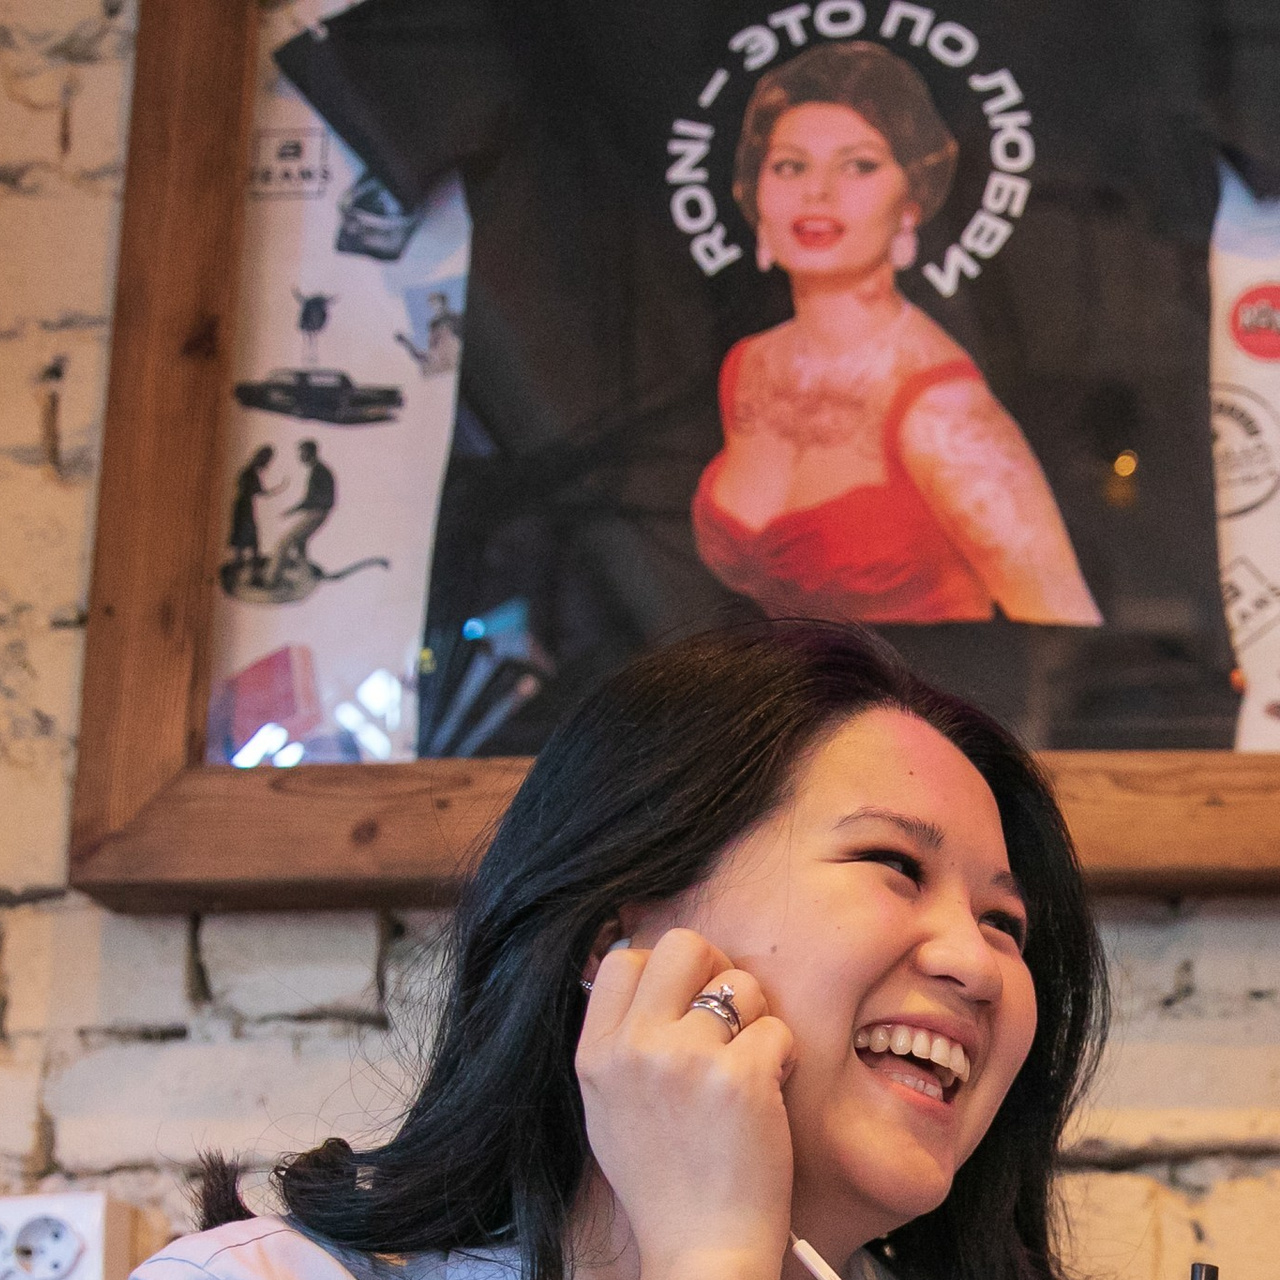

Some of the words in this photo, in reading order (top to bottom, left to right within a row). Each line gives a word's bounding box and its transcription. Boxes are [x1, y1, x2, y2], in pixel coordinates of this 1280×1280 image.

[727, 0, 868, 72] ЭТО
[879, 0, 980, 68] ПО
[666, 117, 742, 277] RONI
[922, 67, 1036, 298] ЛЮБВИ
